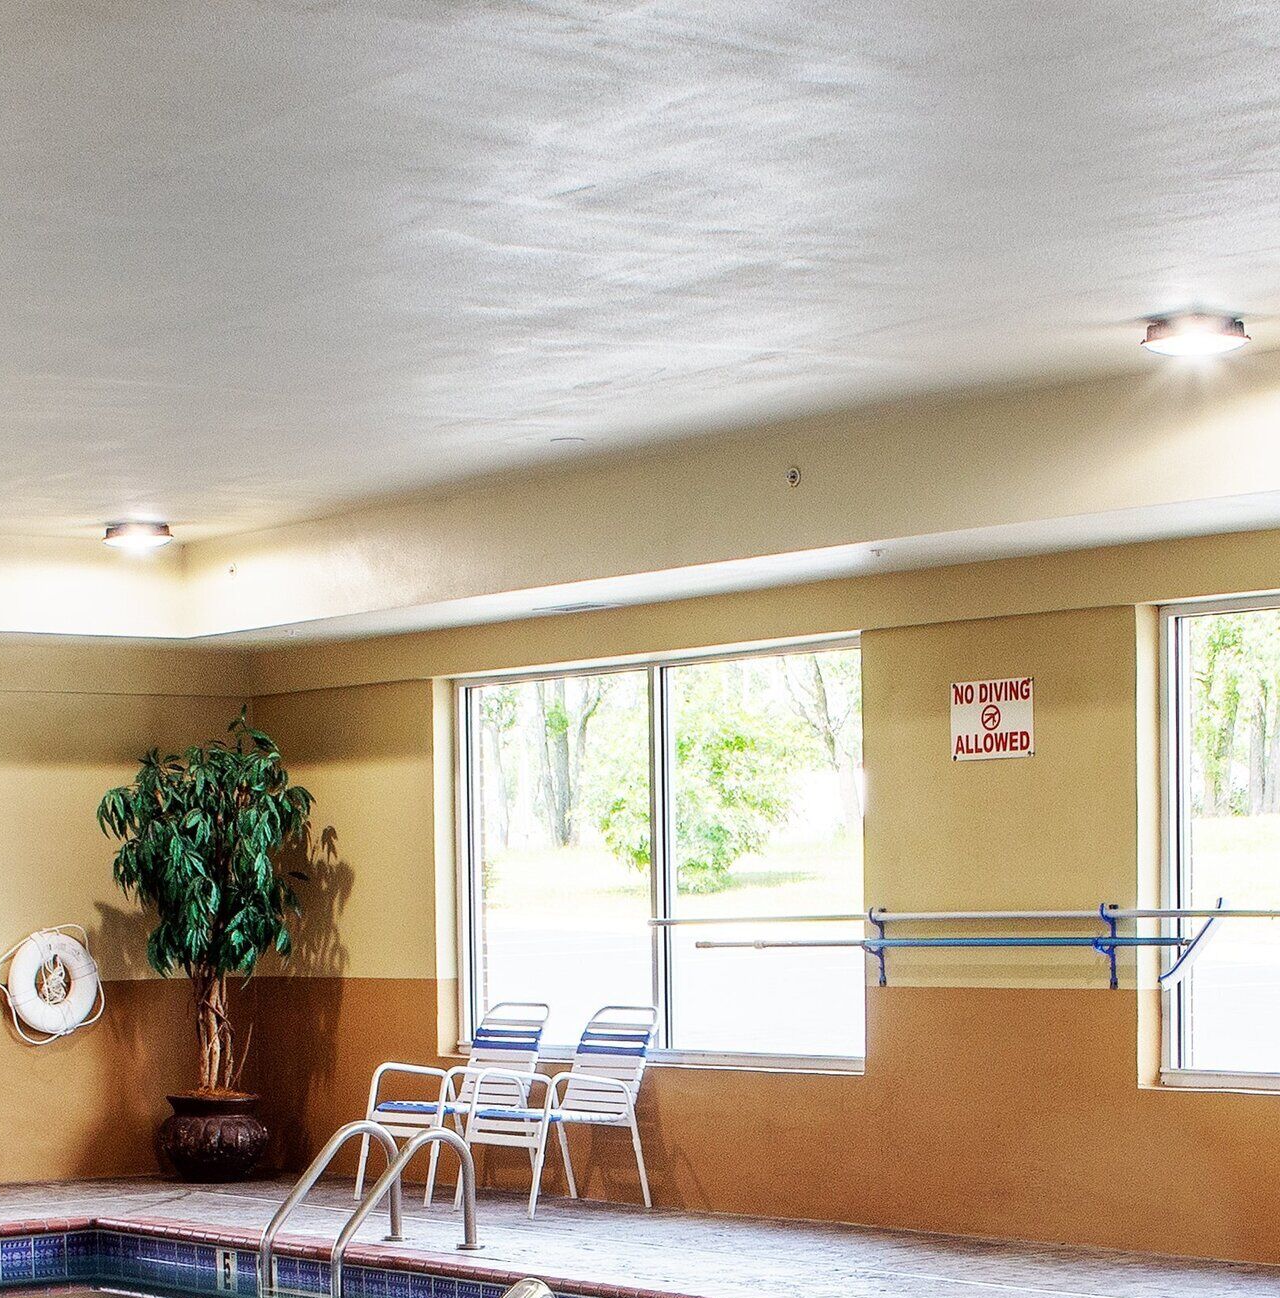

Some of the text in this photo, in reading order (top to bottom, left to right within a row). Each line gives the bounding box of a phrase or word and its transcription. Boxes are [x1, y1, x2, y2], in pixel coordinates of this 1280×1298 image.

[954, 680, 1030, 705] NO DIVING
[956, 731, 1030, 754] ALLOWED
